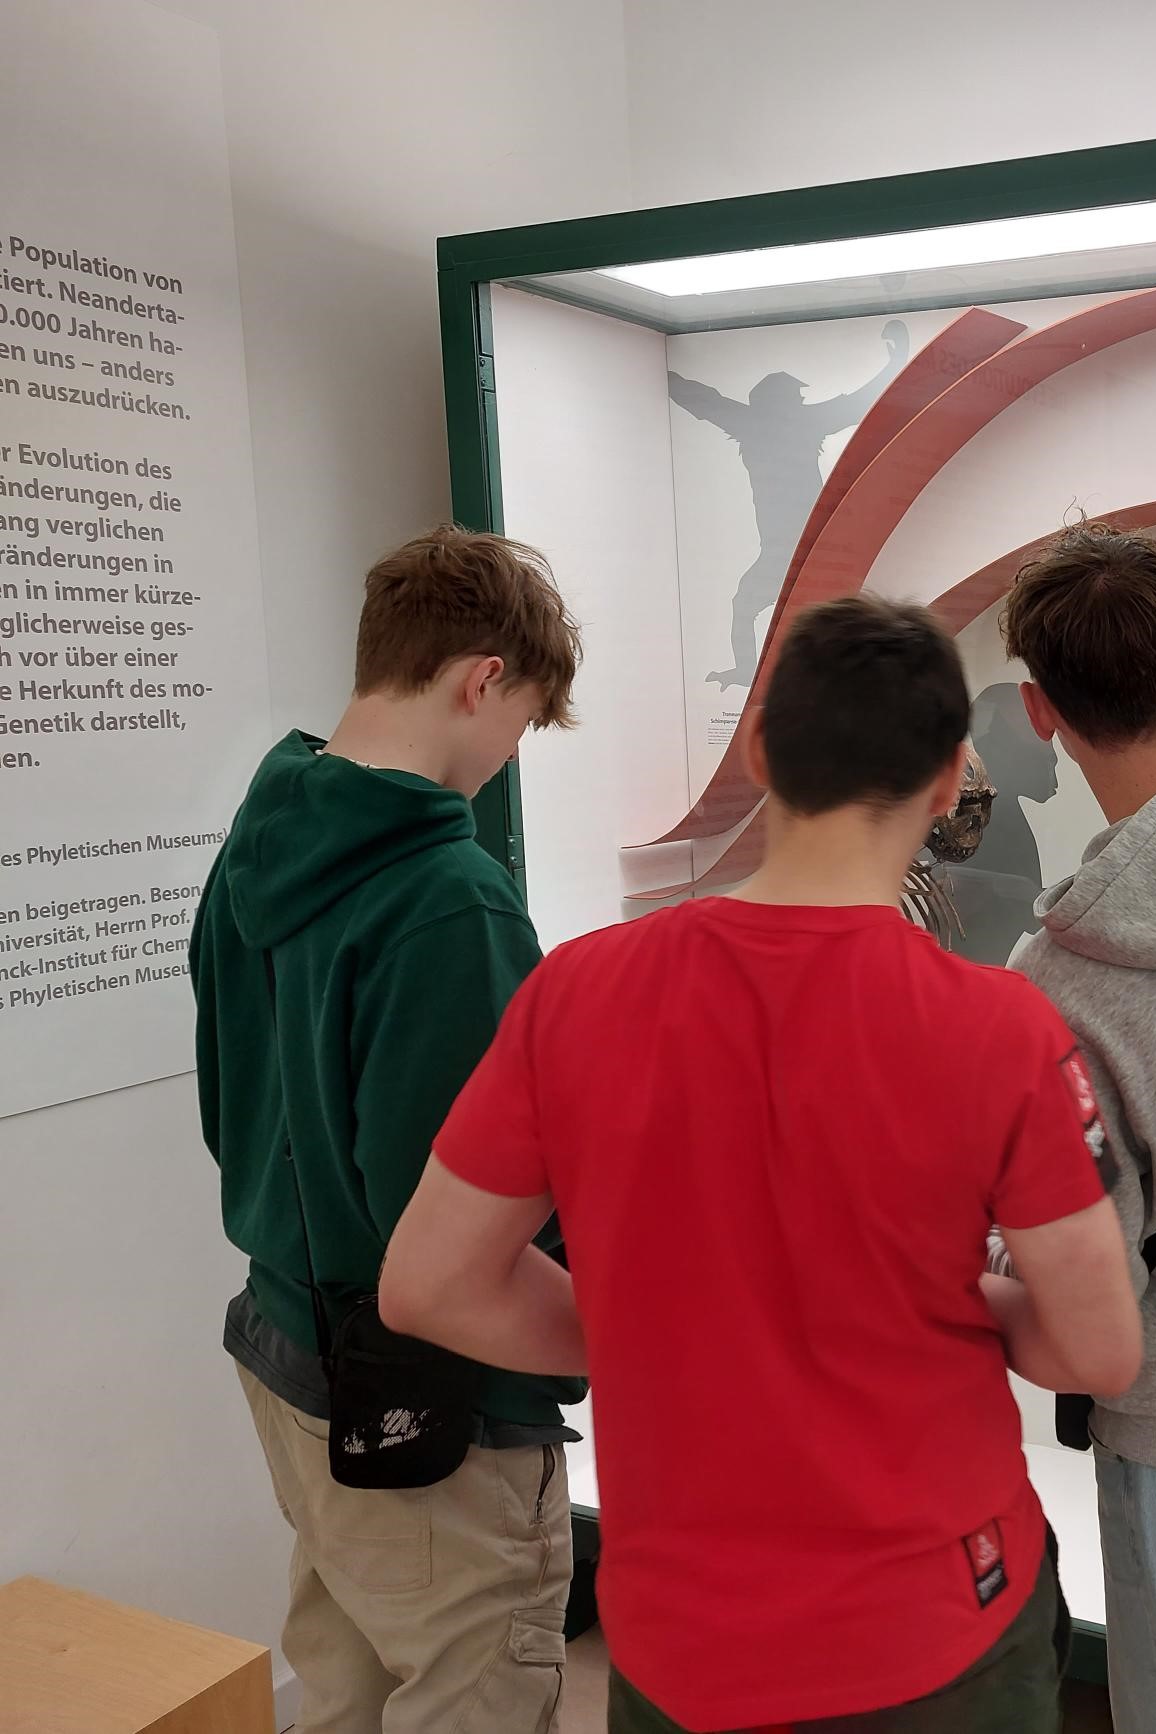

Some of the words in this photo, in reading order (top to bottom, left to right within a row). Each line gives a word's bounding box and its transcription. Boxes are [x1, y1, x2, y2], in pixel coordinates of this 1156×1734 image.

[9, 236, 137, 284] Population
[143, 271, 183, 294] von
[58, 280, 185, 325] Neanderta-
[67, 317, 143, 350] Jahren
[149, 331, 183, 356] ha-
[33, 348, 75, 370] uns
[100, 359, 175, 387] anders
[27, 380, 191, 421] auszudrücken.
[18, 443, 129, 475] Evolution
[135, 457, 173, 480] des
[150, 490, 182, 512] die
[46, 517, 164, 542] verglichen
[154, 553, 174, 574] in
[25, 578, 48, 600] in
[55, 580, 129, 603] immer
[134, 584, 201, 606] kürze-
[150, 618, 194, 641] ges-
[19, 650, 58, 667] vor
[65, 646, 118, 667] über
[124, 647, 178, 667] einer
[19, 678, 124, 701] Herkunft
[129, 679, 167, 699] des
[172, 681, 213, 698] mo-
[90, 709, 187, 732] darstellt,
[0, 751, 41, 768] en.
[27, 838, 142, 868] Phyletischen
[25, 891, 146, 922] beigetragen.
[95, 918, 147, 939] Herrn
[151, 908, 191, 929] Prof.
[111, 944, 138, 963] für
[142, 937, 190, 957] Chem
[9, 972, 130, 1008] Phyletischen
[135, 964, 190, 985] Museu
